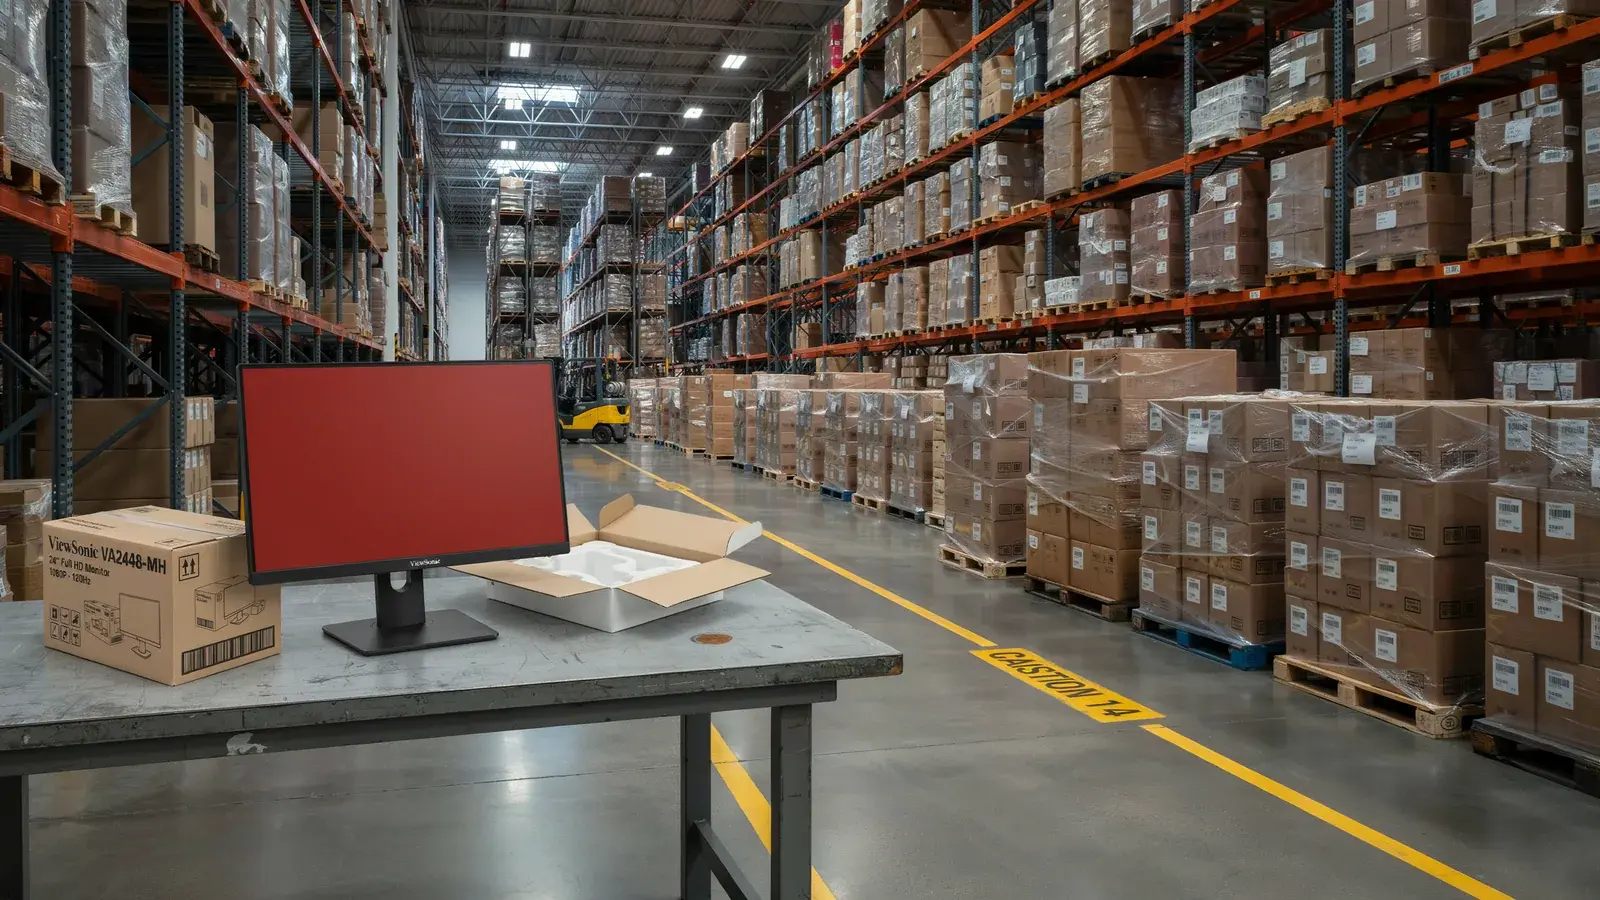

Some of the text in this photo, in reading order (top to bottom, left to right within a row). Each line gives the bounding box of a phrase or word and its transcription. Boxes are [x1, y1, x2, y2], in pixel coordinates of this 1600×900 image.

[48, 535, 167, 575] ViewSonic VA2448-MH
[410, 558, 440, 567] ViewSonic
[61, 557, 72, 568] Full
[73, 560, 84, 571] HD
[85, 563, 110, 577] Monitor
[72, 573, 91, 585] 120Hz
